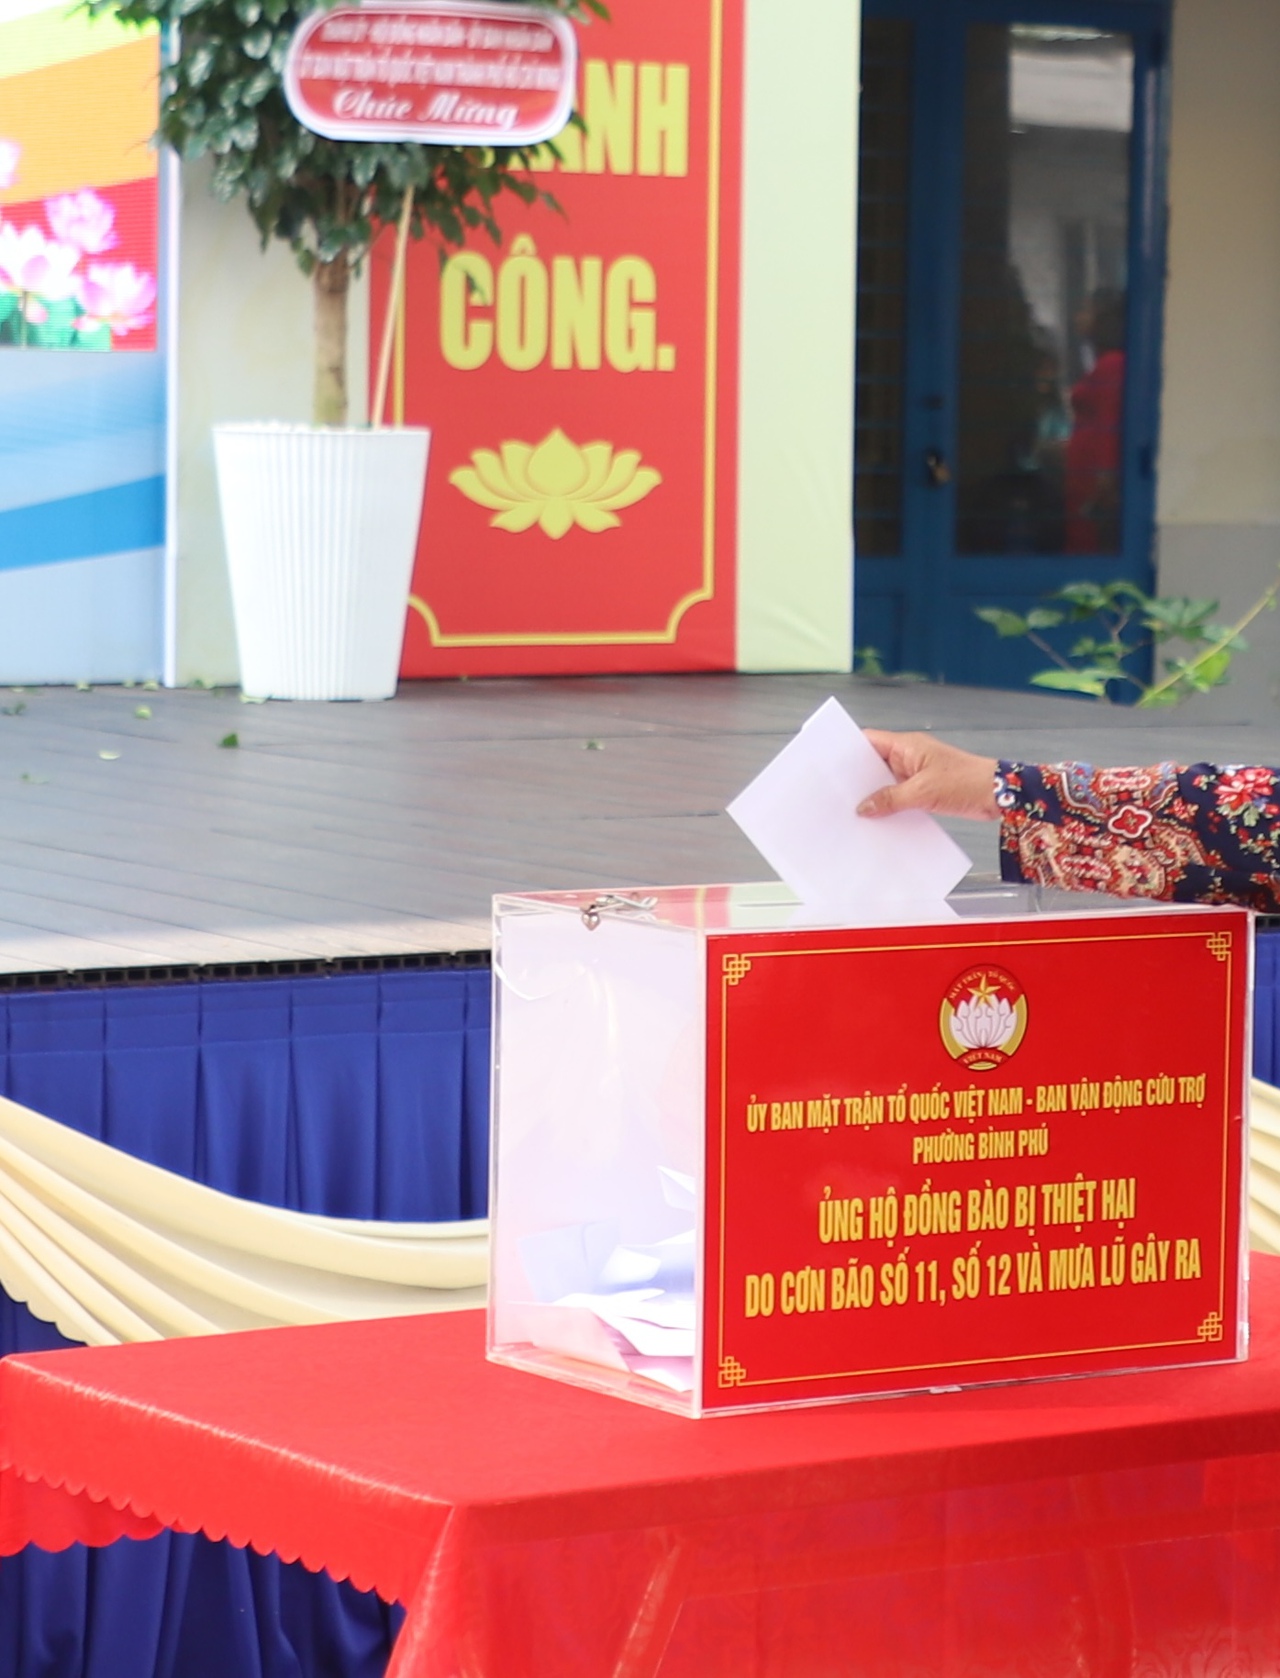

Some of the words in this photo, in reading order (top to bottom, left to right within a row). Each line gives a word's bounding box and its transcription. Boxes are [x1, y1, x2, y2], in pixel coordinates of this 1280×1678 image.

[332, 88, 413, 120] Chúc
[418, 91, 520, 131] Mừng
[439, 233, 676, 372] CÔNG.
[746, 1093, 768, 1132] ỦY
[770, 1100, 804, 1131] BAN
[807, 1093, 842, 1134] MẶT
[843, 1090, 885, 1131] TRẬN
[887, 1082, 908, 1123] TỔ
[910, 1082, 951, 1125] QUỐC
[953, 1083, 986, 1124] VIỆT
[988, 1086, 1023, 1116] NAM
[1036, 1084, 1068, 1113] BAN
[1070, 1077, 1100, 1117] VẬN
[1103, 1075, 1143, 1114] ĐỘNG
[1146, 1072, 1175, 1106] CỨU
[1178, 1072, 1206, 1109] TRỢ
[913, 1127, 975, 1165] PHƯỜNG
[978, 1125, 1015, 1160] BÌNH
[1018, 1122, 1049, 1157] PHÚ
[818, 1186, 864, 1244] ỦNG
[869, 1186, 899, 1248] HỘ
[903, 1178, 962, 1237] ĐỒNG
[967, 1179, 1010, 1232] BÀO
[1014, 1184, 1037, 1237] BỊ
[1041, 1172, 1097, 1233] THIỆT
[1101, 1177, 1136, 1229] HẠI
[745, 1272, 775, 1318] DO
[780, 1265, 826, 1315] CƠN
[830, 1257, 875, 1310] BÃO
[879, 1246, 910, 1306] SỐ
[915, 1259, 946, 1306] 11,
[952, 1240, 982, 1300] SỐ
[986, 1254, 1012, 1297] 12
[1016, 1242, 1044, 1294] VÀ
[1048, 1242, 1096, 1291] MƯA
[1101, 1236, 1126, 1287] LŨ
[1130, 1232, 1171, 1284] GÂY
[1174, 1238, 1202, 1280] RA
